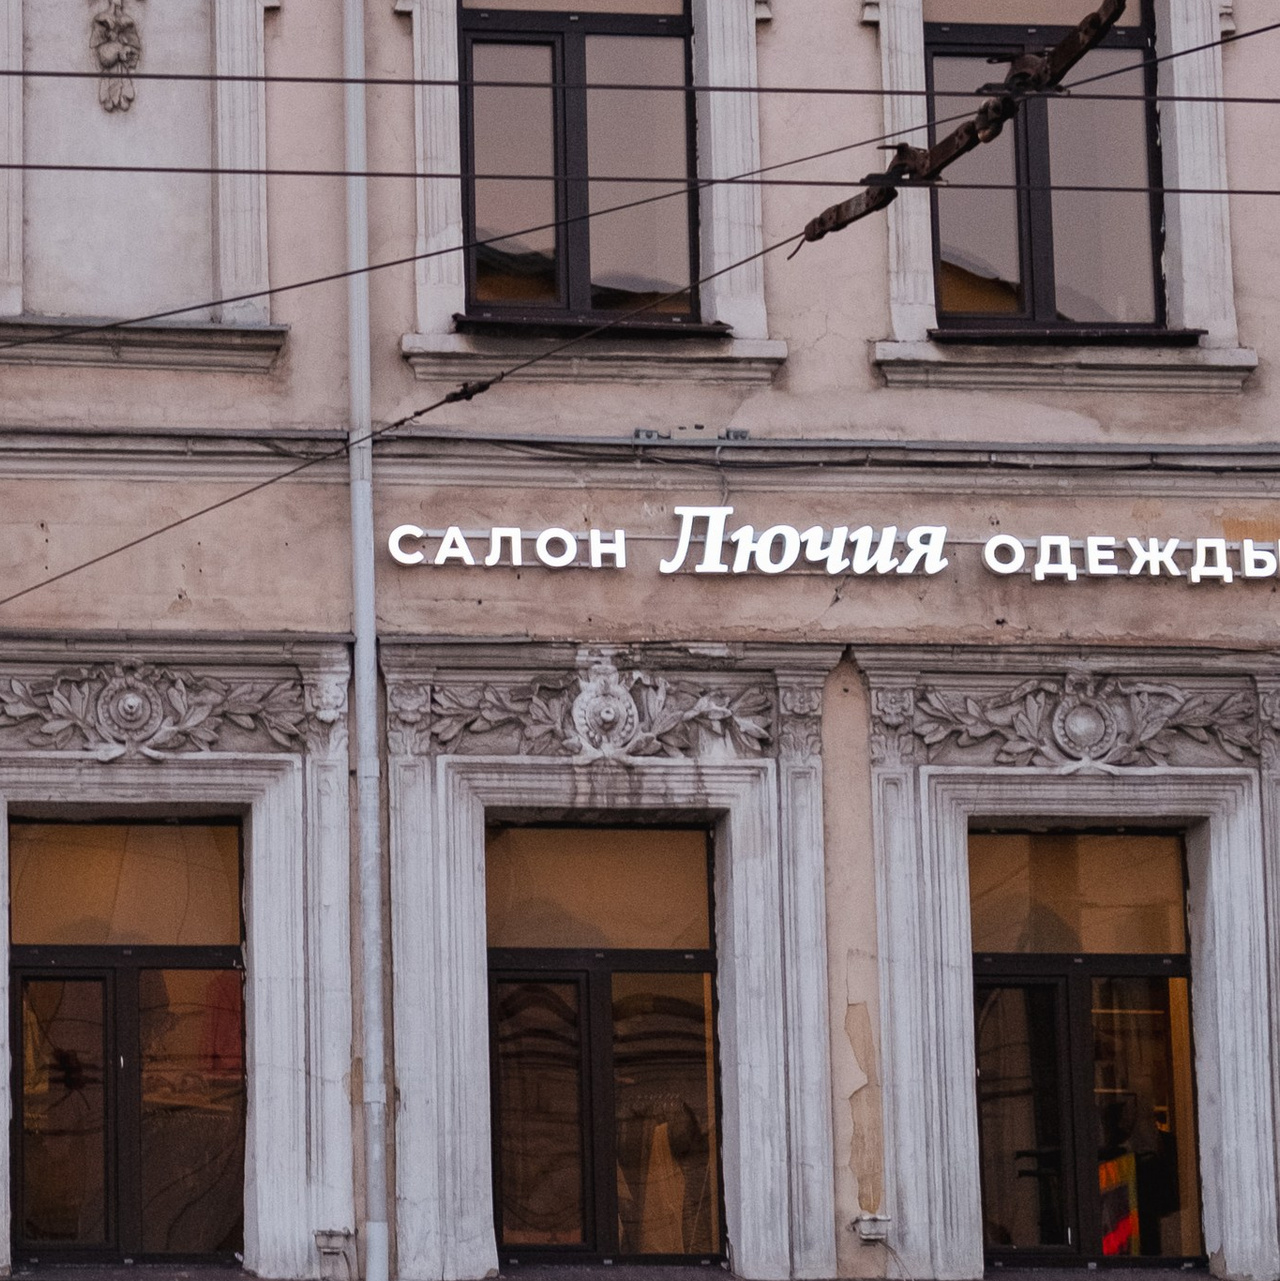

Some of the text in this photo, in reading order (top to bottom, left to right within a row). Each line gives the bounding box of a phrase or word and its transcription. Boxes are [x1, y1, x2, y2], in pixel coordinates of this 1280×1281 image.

[387, 505, 1280, 585] САЛОН Лючия ОДЕЖДЫ
